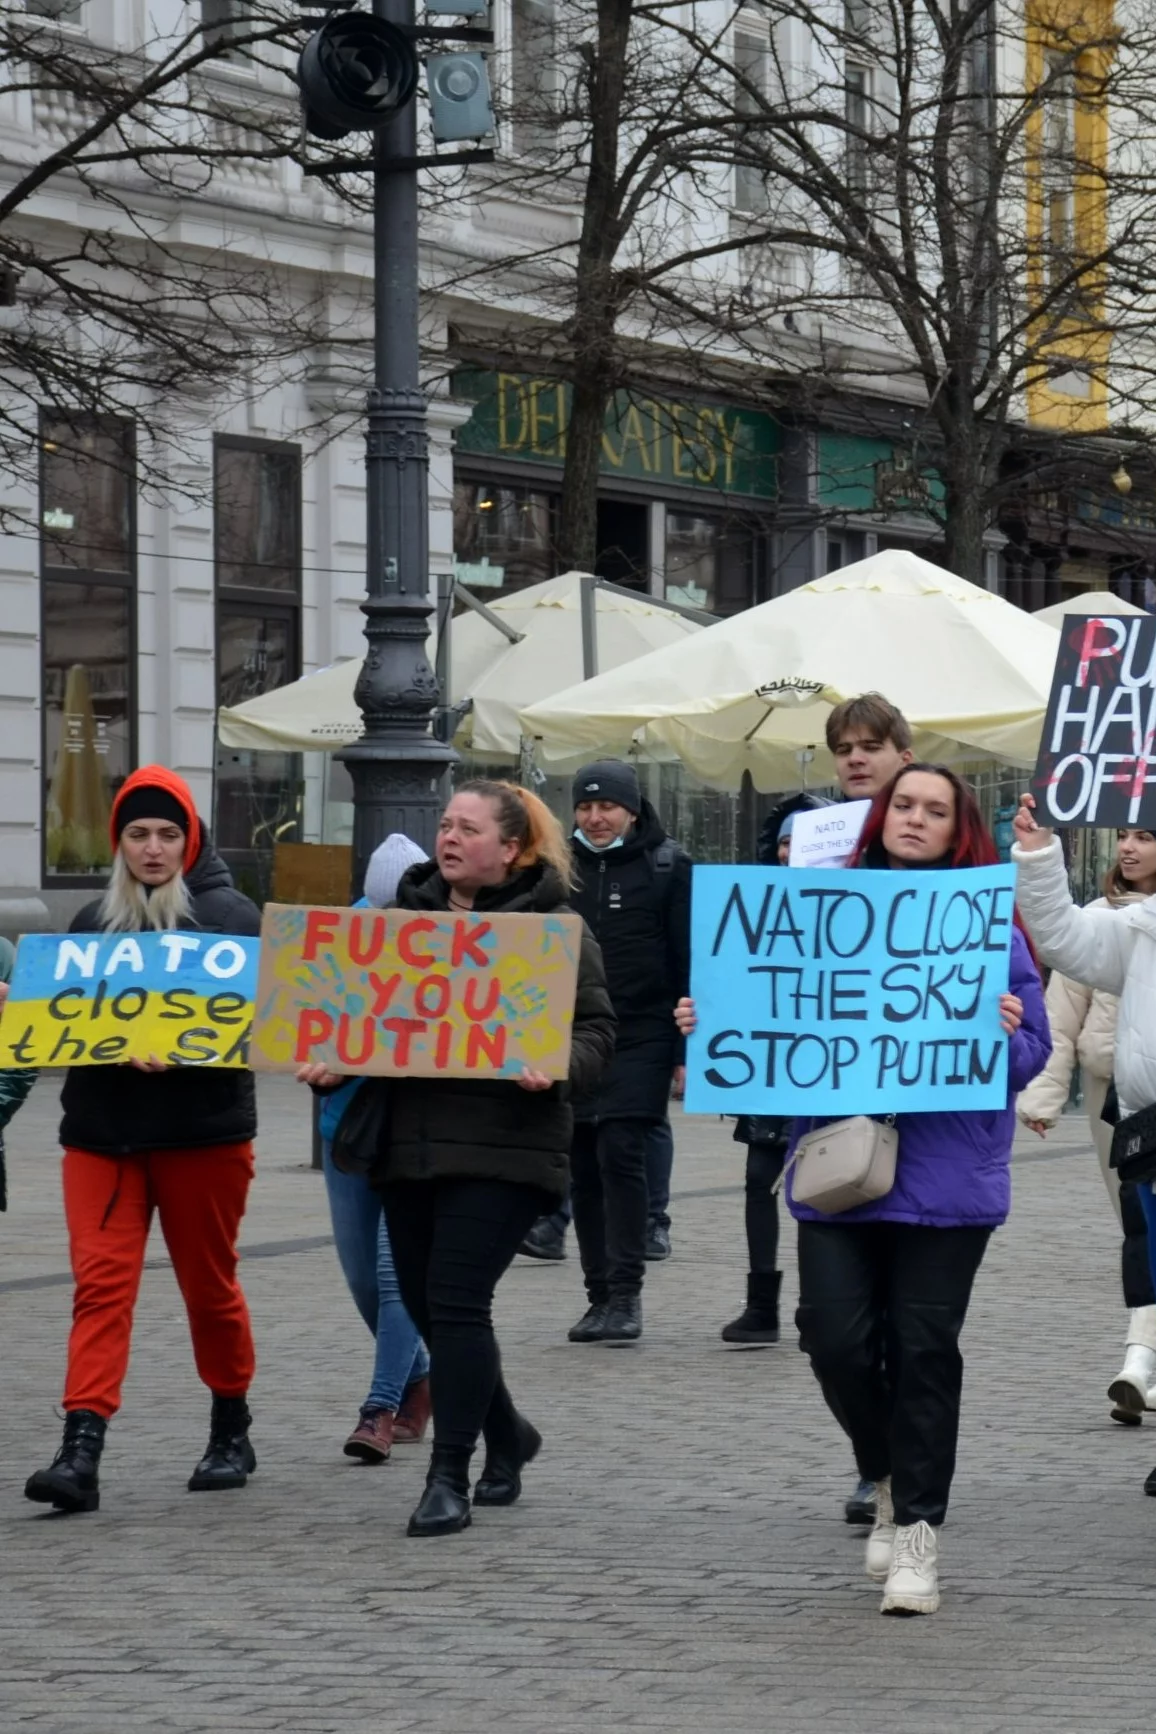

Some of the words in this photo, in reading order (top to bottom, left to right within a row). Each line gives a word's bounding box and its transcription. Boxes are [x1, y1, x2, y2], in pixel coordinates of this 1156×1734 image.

[498, 372, 739, 484] DELKATESY
[844, 838, 857, 849] SK
[300, 910, 493, 969] FUCK
[712, 882, 876, 960] NATO
[886, 886, 1014, 959] CLOSE
[54, 934, 247, 980] NATO
[48, 979, 247, 1025] close
[368, 971, 500, 1022] YOU
[747, 965, 872, 1021] THE
[880, 963, 987, 1023] SKY
[8, 1025, 129, 1064] the
[167, 1020, 253, 1065] Sk
[294, 1008, 507, 1069] PUTIN
[704, 1029, 860, 1090] STOP
[871, 1034, 1004, 1089] PUTIN
